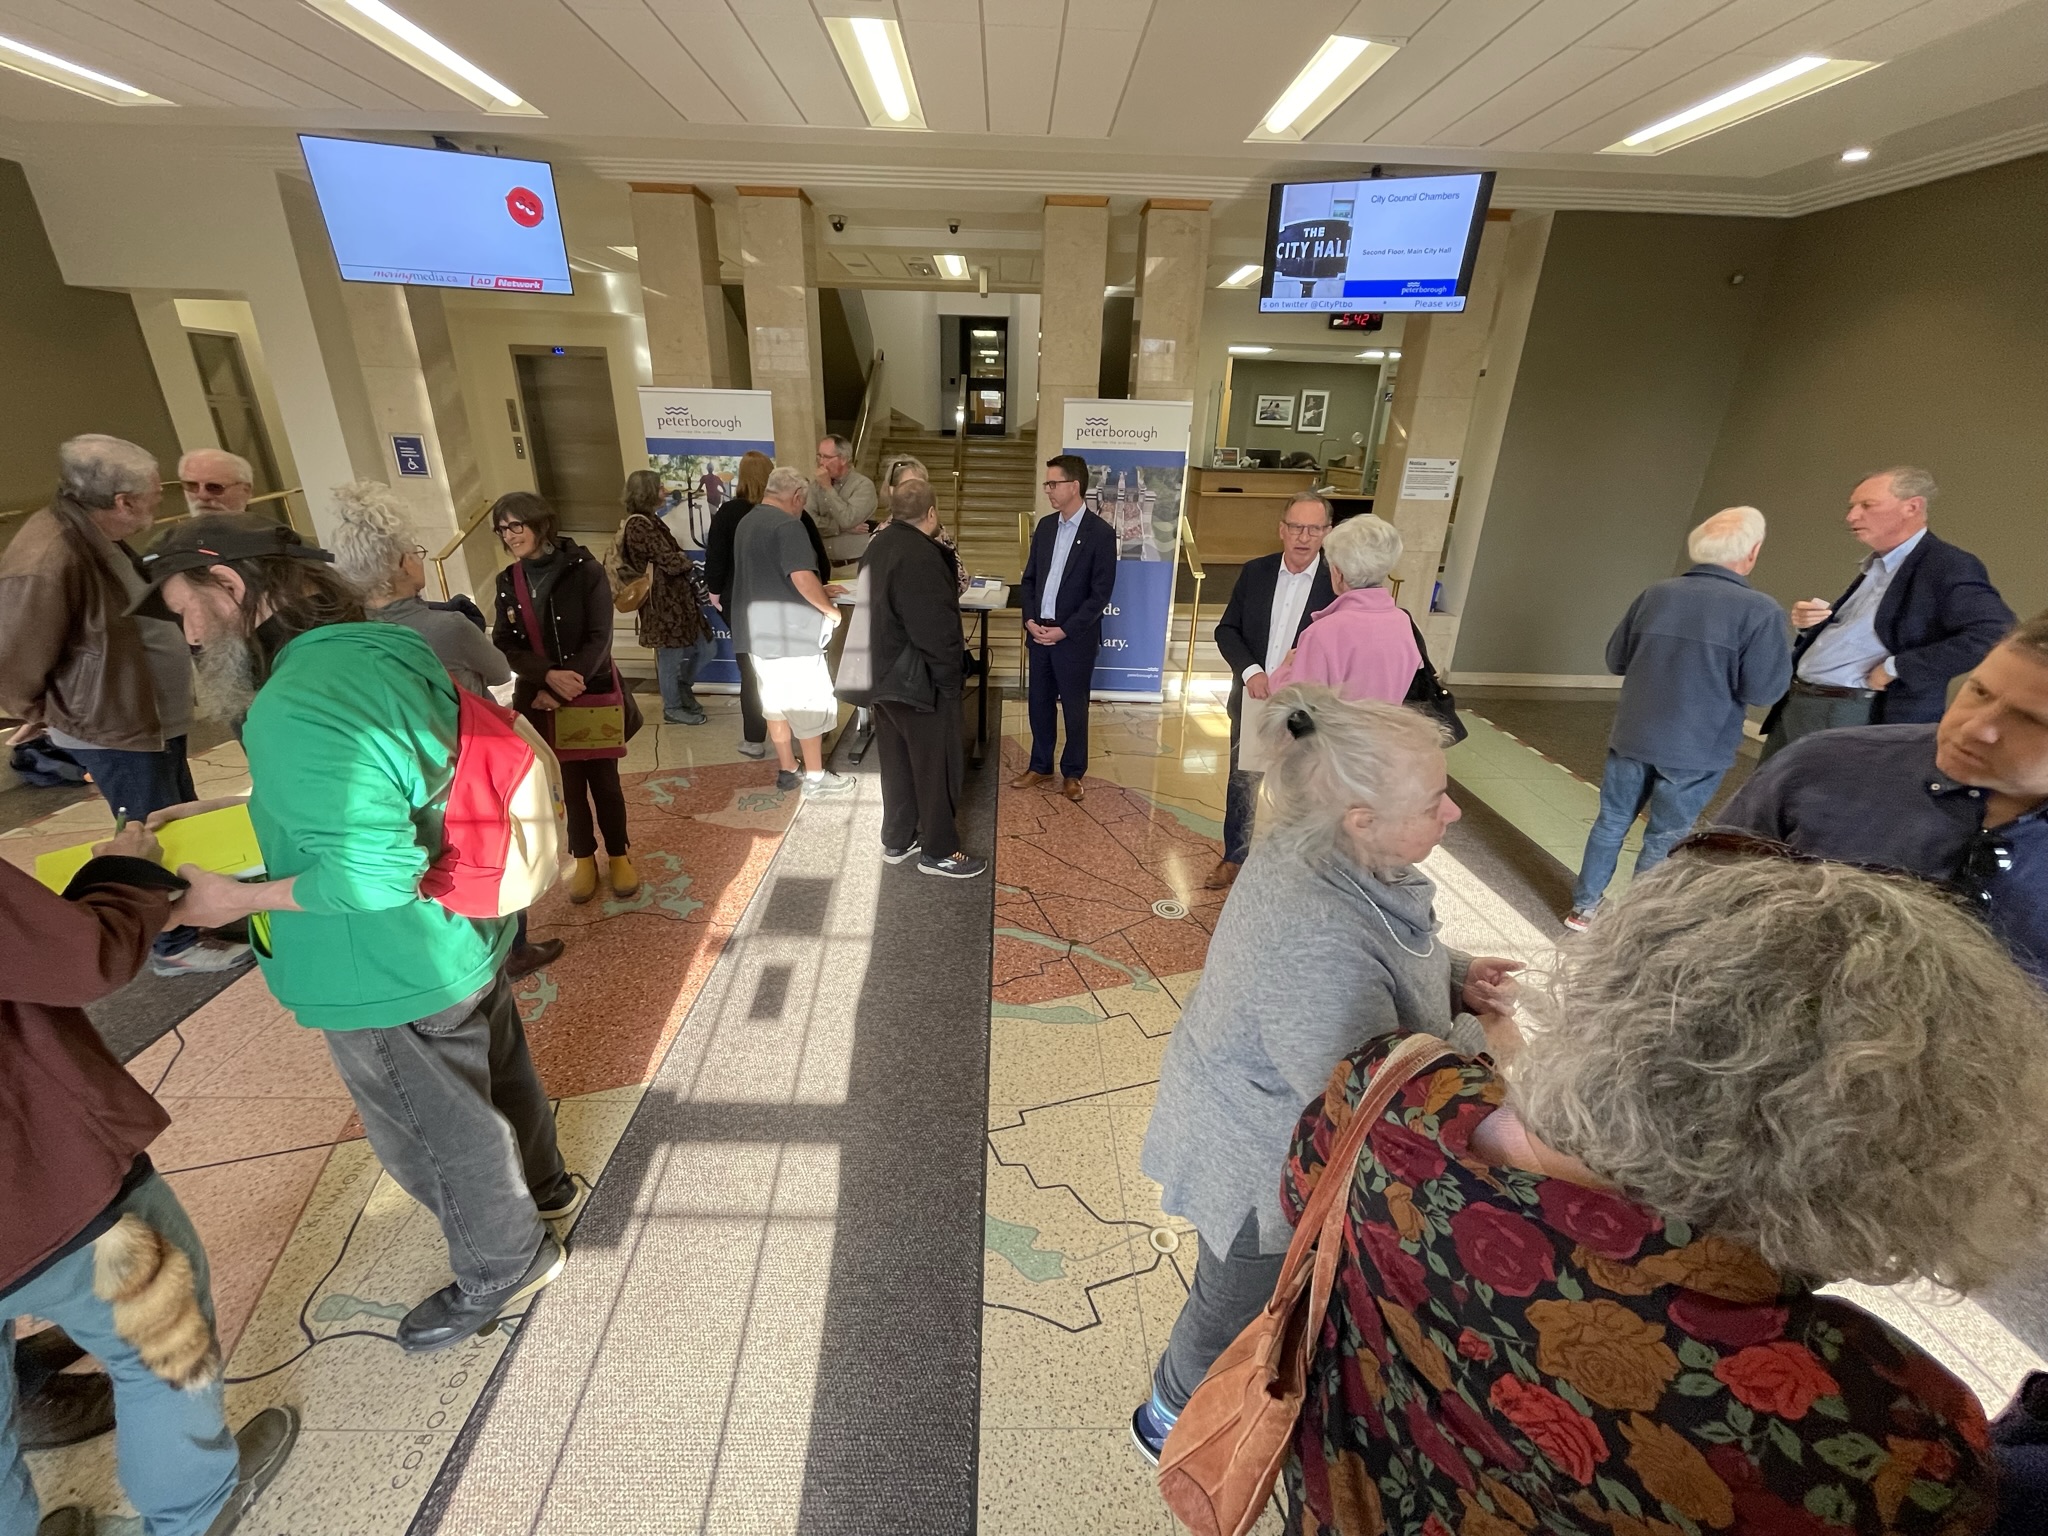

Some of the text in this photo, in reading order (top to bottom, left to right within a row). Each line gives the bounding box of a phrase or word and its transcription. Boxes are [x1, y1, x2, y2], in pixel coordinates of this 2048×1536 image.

[1371, 192, 1460, 205] City Council Chambers
[1303, 226, 1326, 238] THE
[1276, 241, 1310, 259] CITY
[1362, 248, 1386, 256] Second
[1424, 247, 1437, 255] City
[498, 278, 541, 289] Network
[1401, 285, 1448, 296] peterborough
[1282, 300, 1308, 308] twitter
[1310, 300, 1353, 309] @CityPtbo
[657, 414, 742, 432] peterborough
[1076, 425, 1158, 443] peterborough
[391, 1337, 491, 1490] COBOCONK
